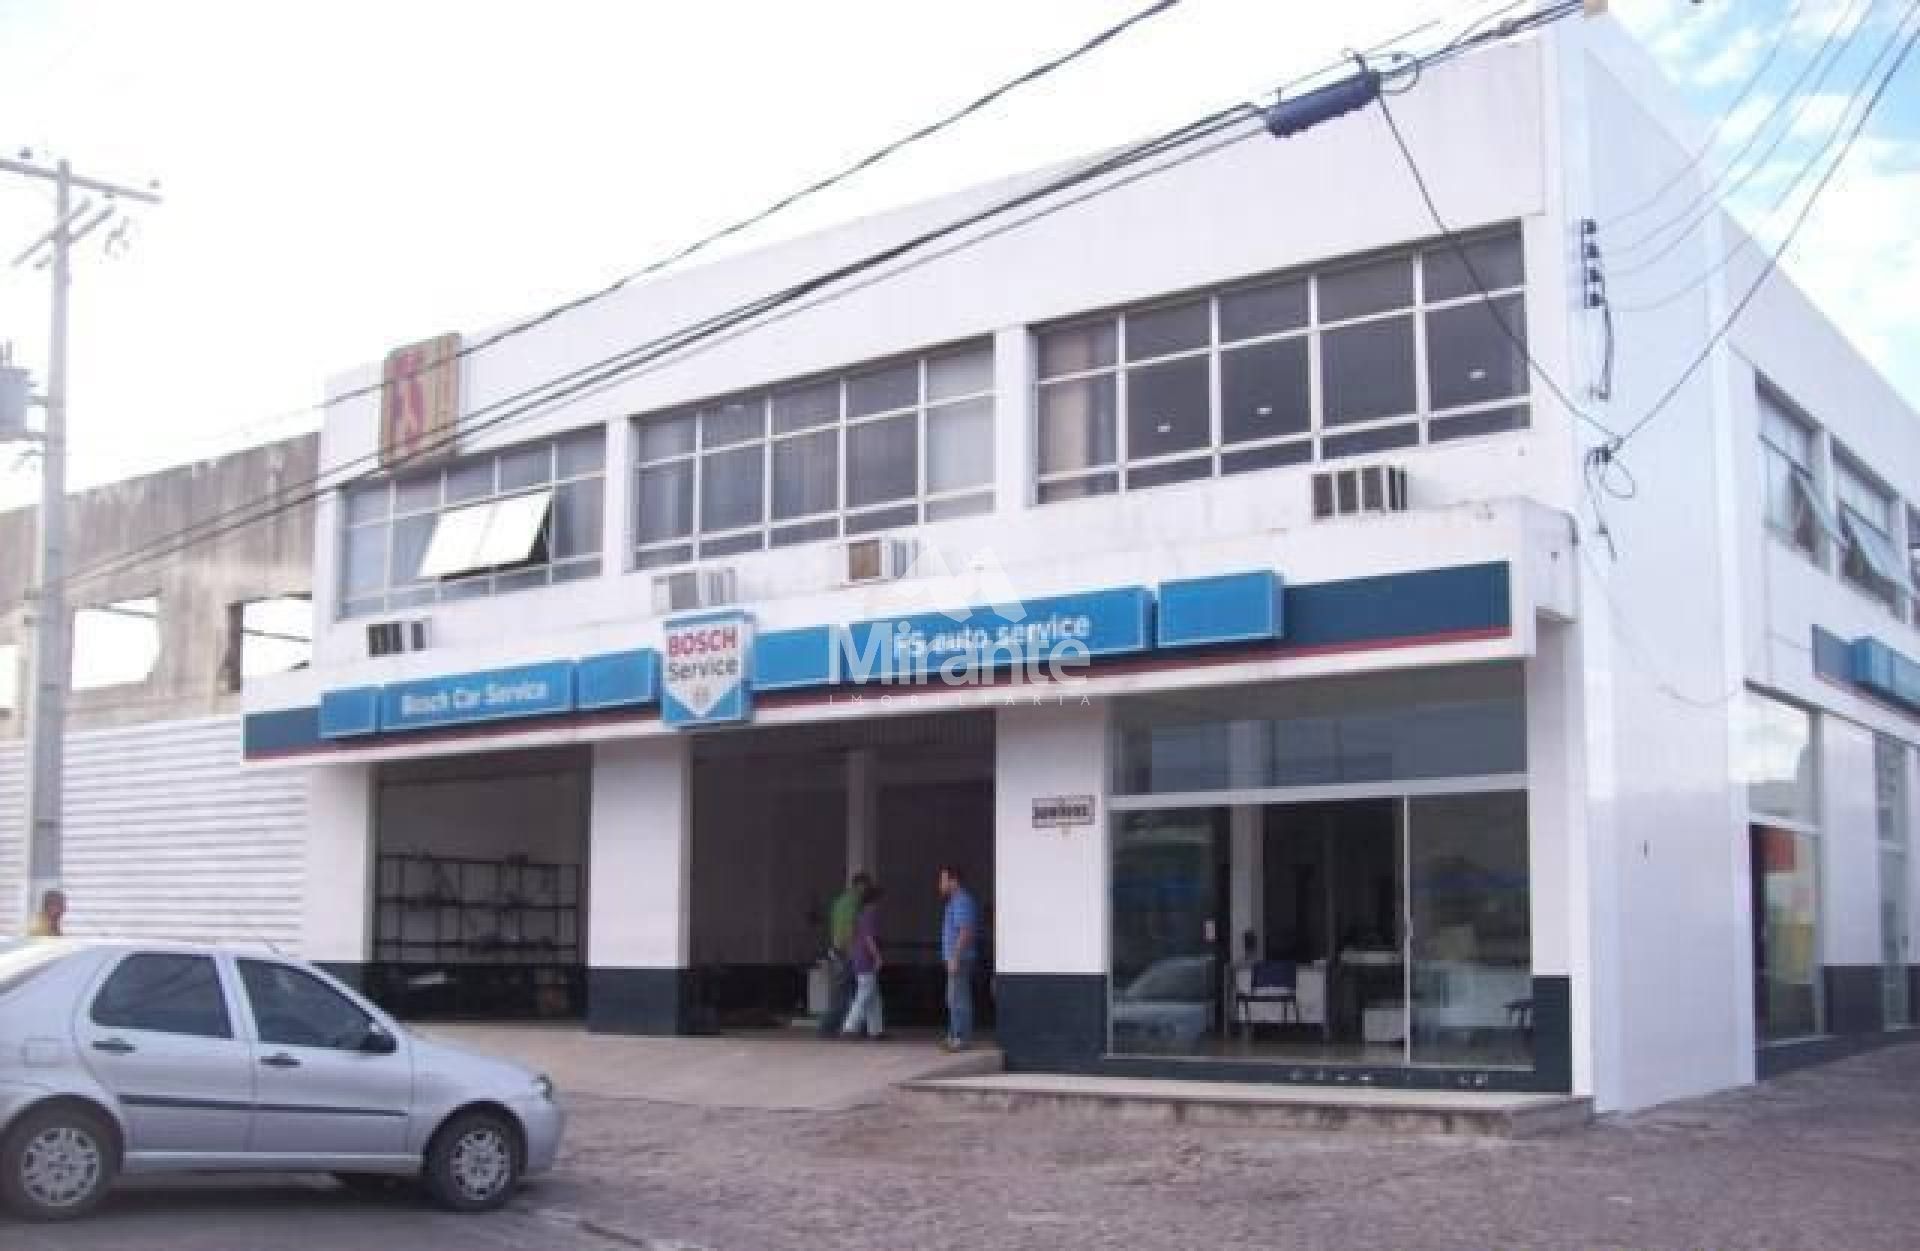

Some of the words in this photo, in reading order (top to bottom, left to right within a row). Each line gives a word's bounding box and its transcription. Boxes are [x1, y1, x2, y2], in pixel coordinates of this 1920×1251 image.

[997, 612, 1091, 643] service
[668, 627, 736, 658] BOSCH
[668, 656, 739, 681] Service
[484, 681, 549, 704] Service
